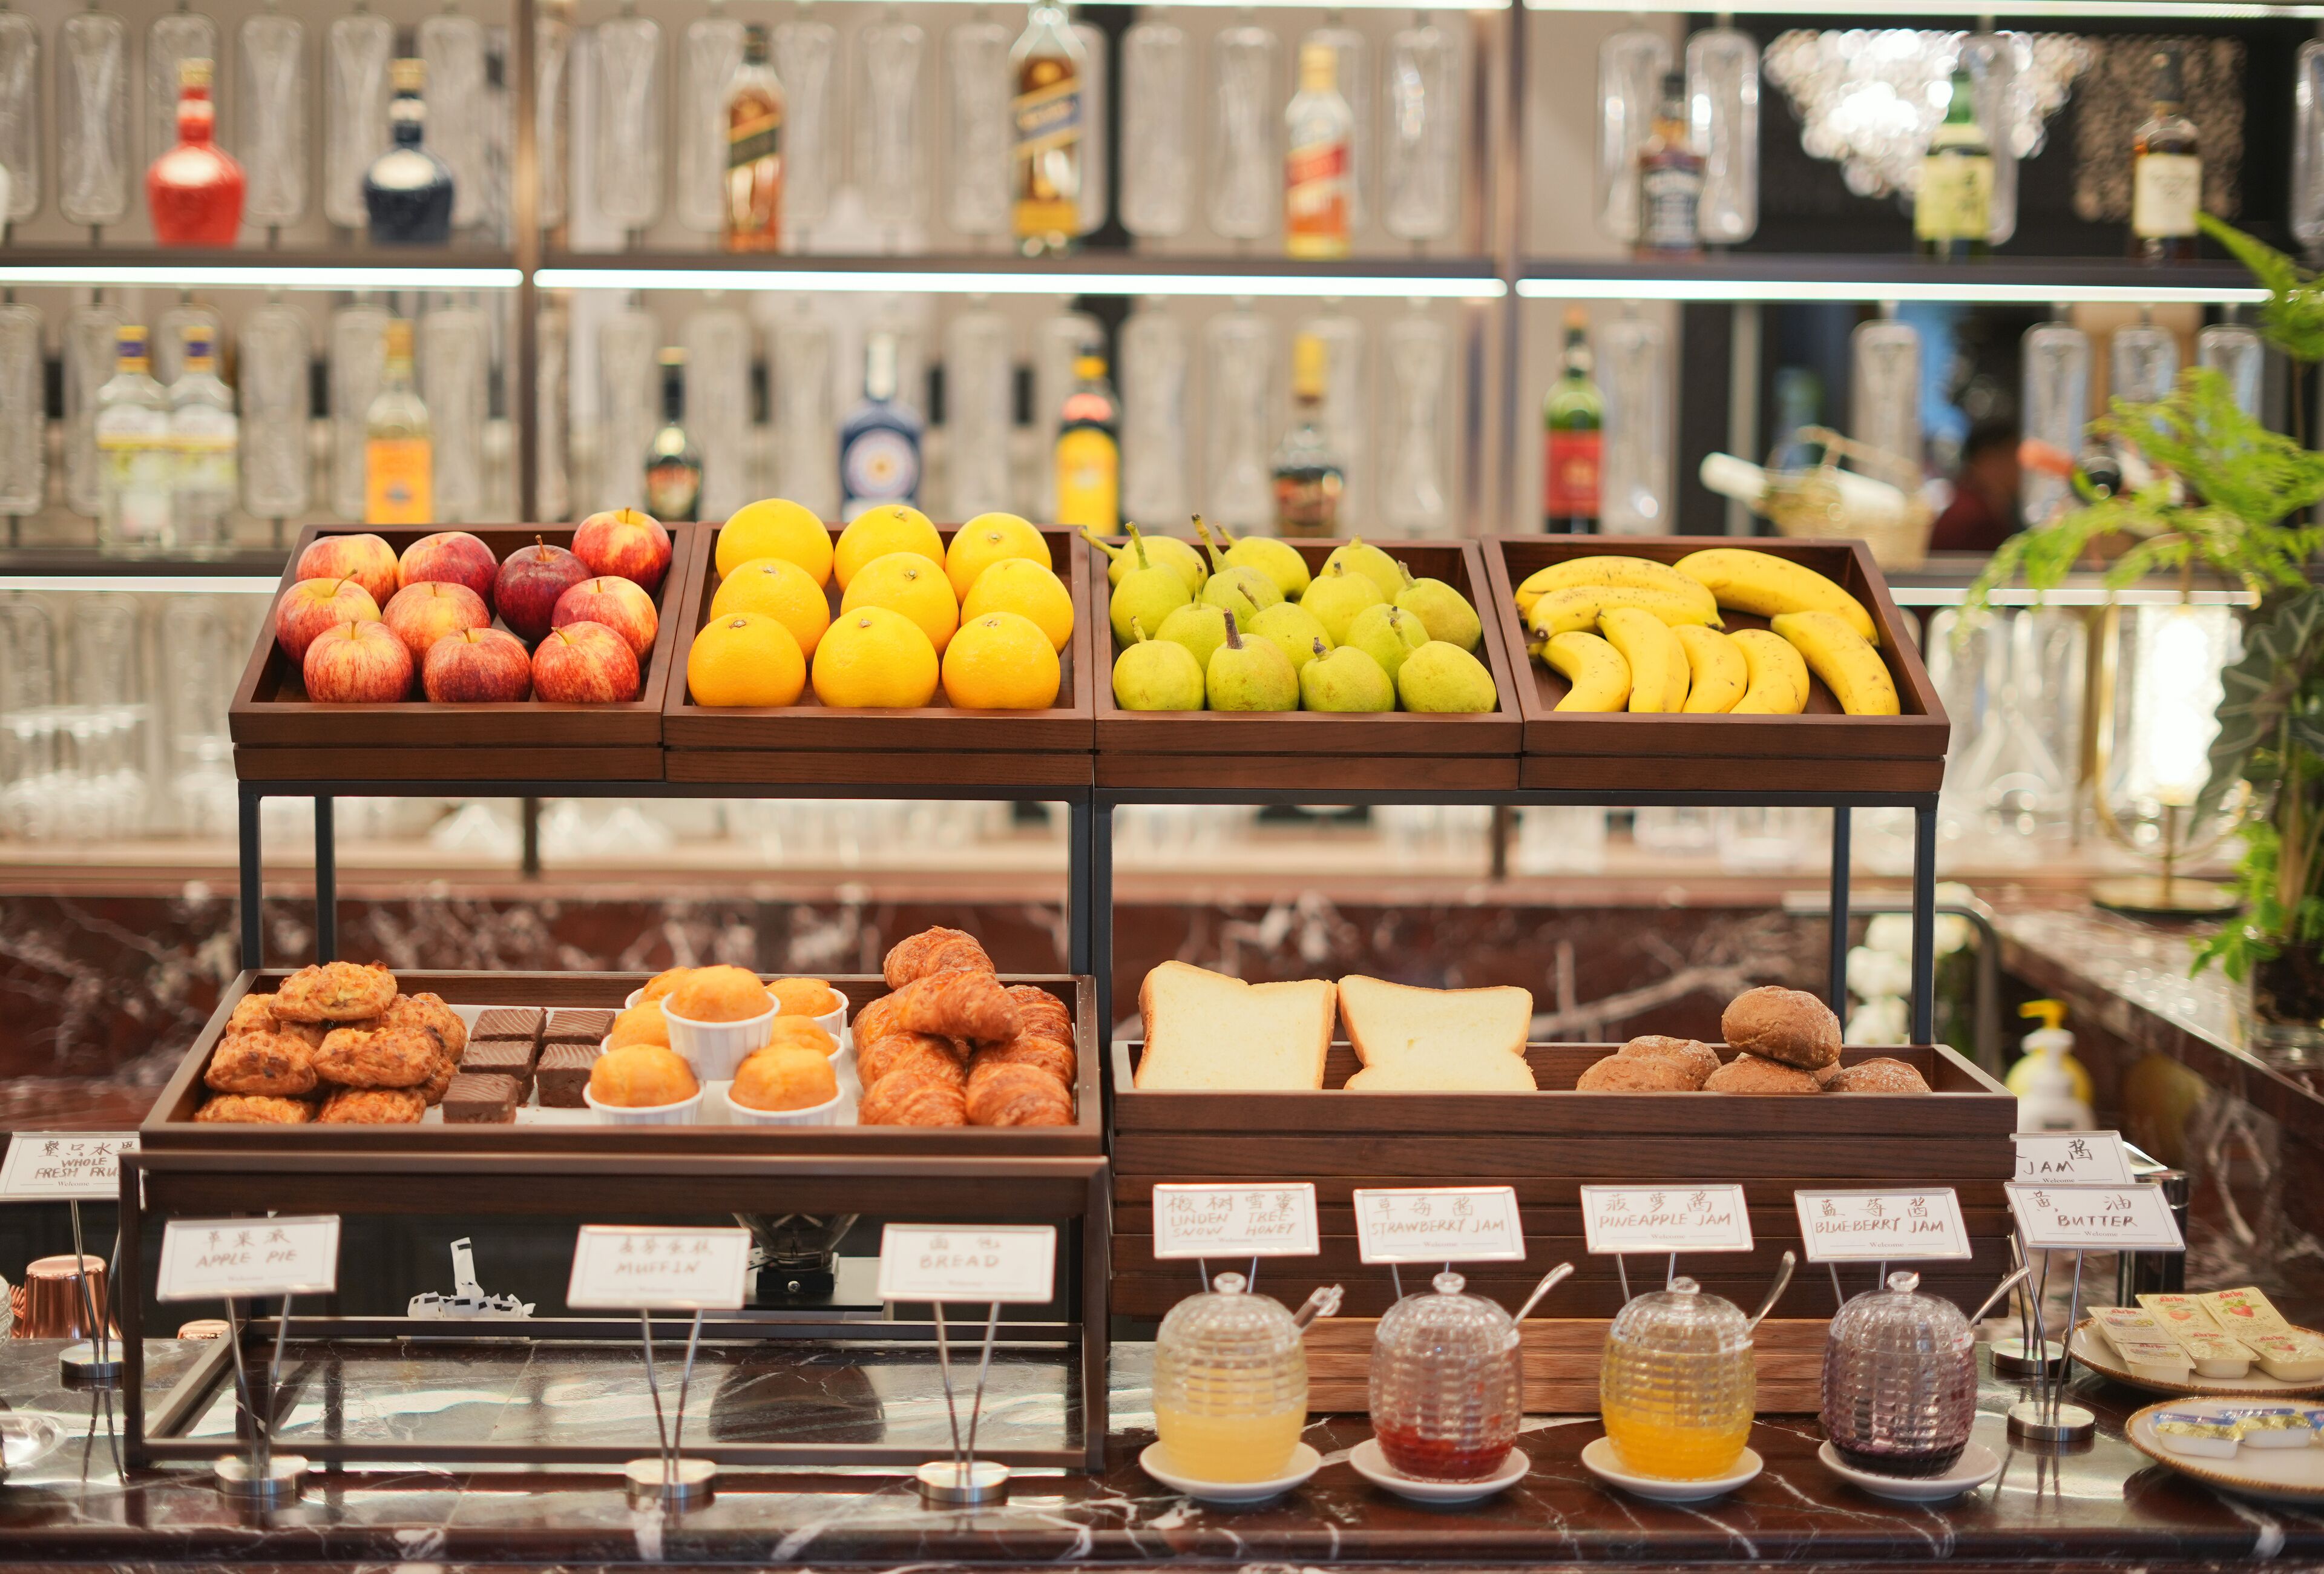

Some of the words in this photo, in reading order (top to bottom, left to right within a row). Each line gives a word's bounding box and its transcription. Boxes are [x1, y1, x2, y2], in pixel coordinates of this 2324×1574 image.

[61, 1157, 107, 1167] WHOLE
[2023, 1161, 2075, 1174] JAM
[34, 1168, 79, 1179] FRESH
[90, 1167, 119, 1177] FRU
[2027, 1190, 2132, 1212] 黄油
[1170, 1213, 1228, 1227] LINDEN
[1249, 1211, 1290, 1223] TREE
[1599, 1213, 1687, 1228] PINEAPPLE
[1695, 1213, 1730, 1226] JAM
[1816, 1217, 1901, 1233] BLUEBERRY
[1908, 1220, 1944, 1233] JAM
[2058, 1215, 2138, 1227] BUTTER
[1173, 1226, 1224, 1237] SNOW
[1245, 1222, 1295, 1236] HONEY
[1371, 1218, 1465, 1236] STRAWBERRY
[1472, 1219, 1504, 1233] JAM
[195, 1252, 251, 1268] APPLE
[266, 1250, 297, 1263] PIE
[920, 1254, 1000, 1269] BREAD
[615, 1260, 700, 1275] MUFFIN
